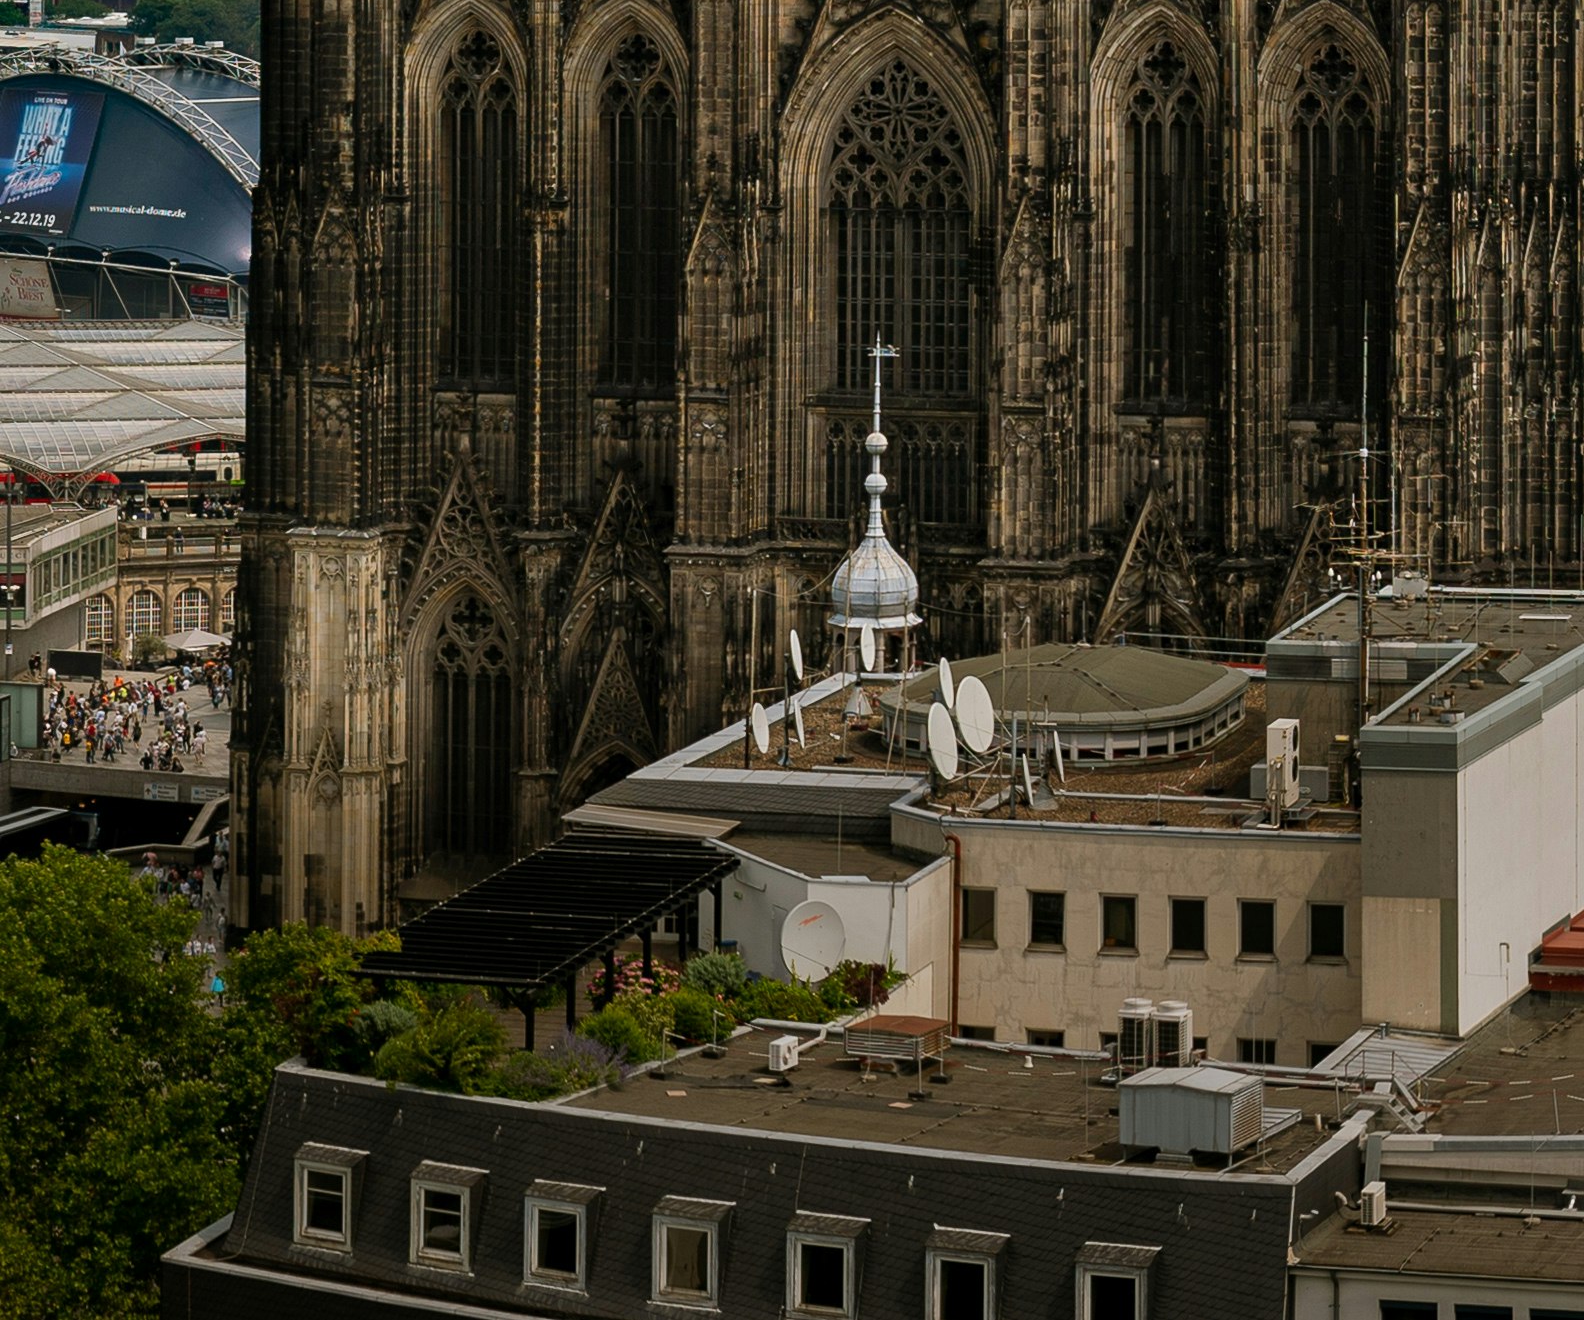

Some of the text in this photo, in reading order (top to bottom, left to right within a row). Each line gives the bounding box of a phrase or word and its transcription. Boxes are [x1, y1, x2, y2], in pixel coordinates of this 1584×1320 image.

[22, 104, 73, 137] WHAT A
[11, 211, 56, 227] 22.12.19
[89, 205, 187, 219] www.musical-dome.de
